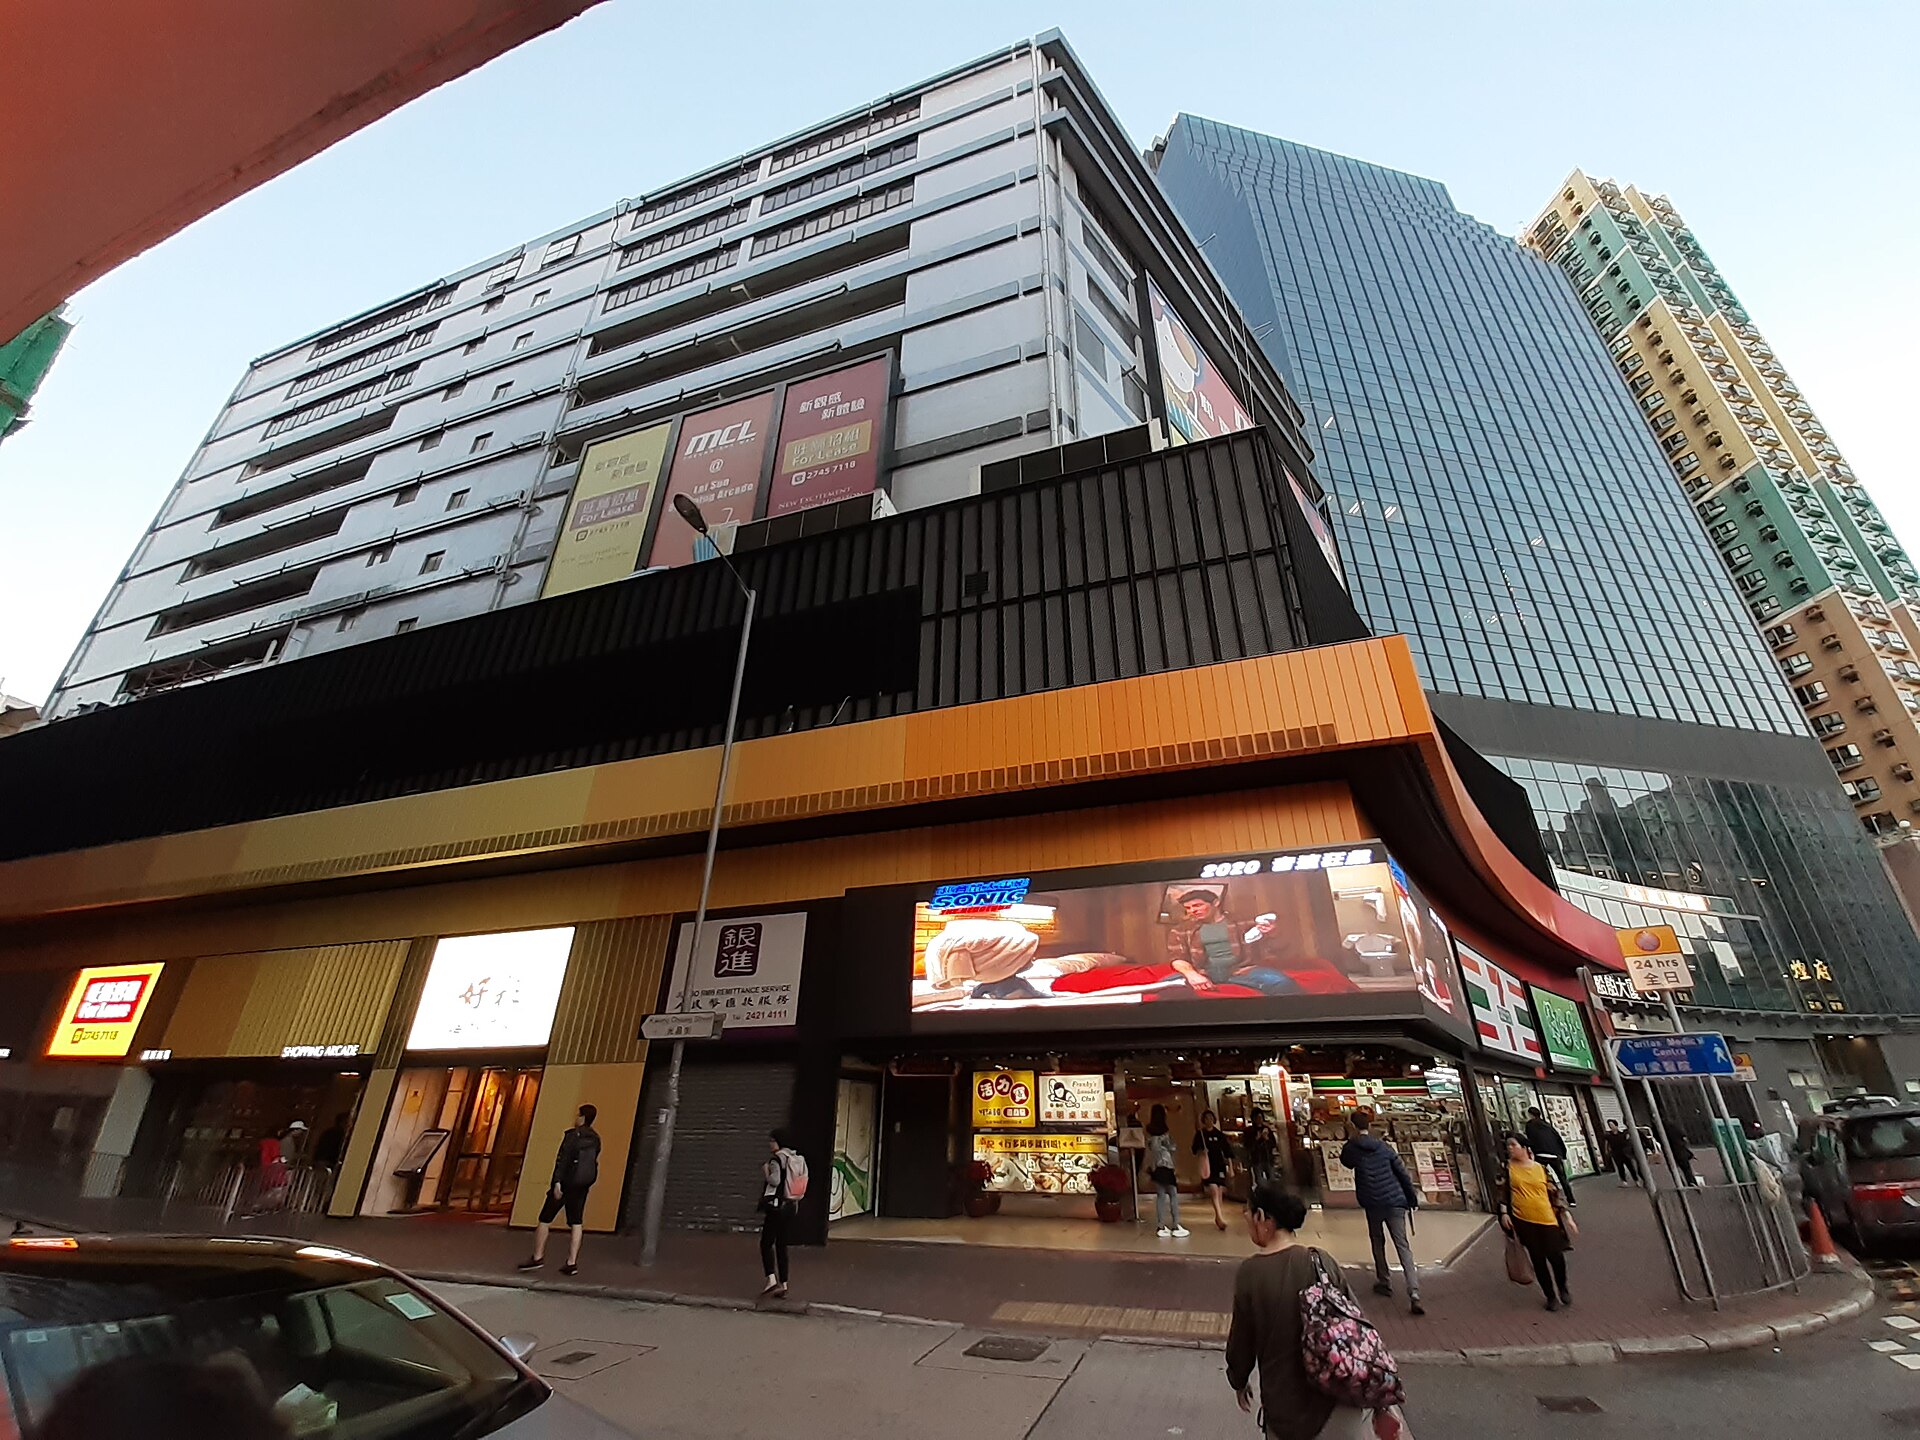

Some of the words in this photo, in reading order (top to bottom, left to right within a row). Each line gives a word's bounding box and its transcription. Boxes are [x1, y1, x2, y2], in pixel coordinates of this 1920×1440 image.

[684, 420, 757, 456] MCL
[709, 458, 724, 473] @
[807, 467, 830, 480] 2745
[1200, 860, 1261, 878] 2020
[931, 889, 1027, 909] SONIC
[1634, 960, 1653, 969] 24
[1657, 958, 1679, 968] hrs
[1644, 971, 1680, 986] 全日
[746, 1011, 765, 1020] 2421
[767, 1010, 787, 1019] 4111
[282, 1046, 324, 1057] SHOPPING
[324, 1045, 360, 1056] ARCADE
